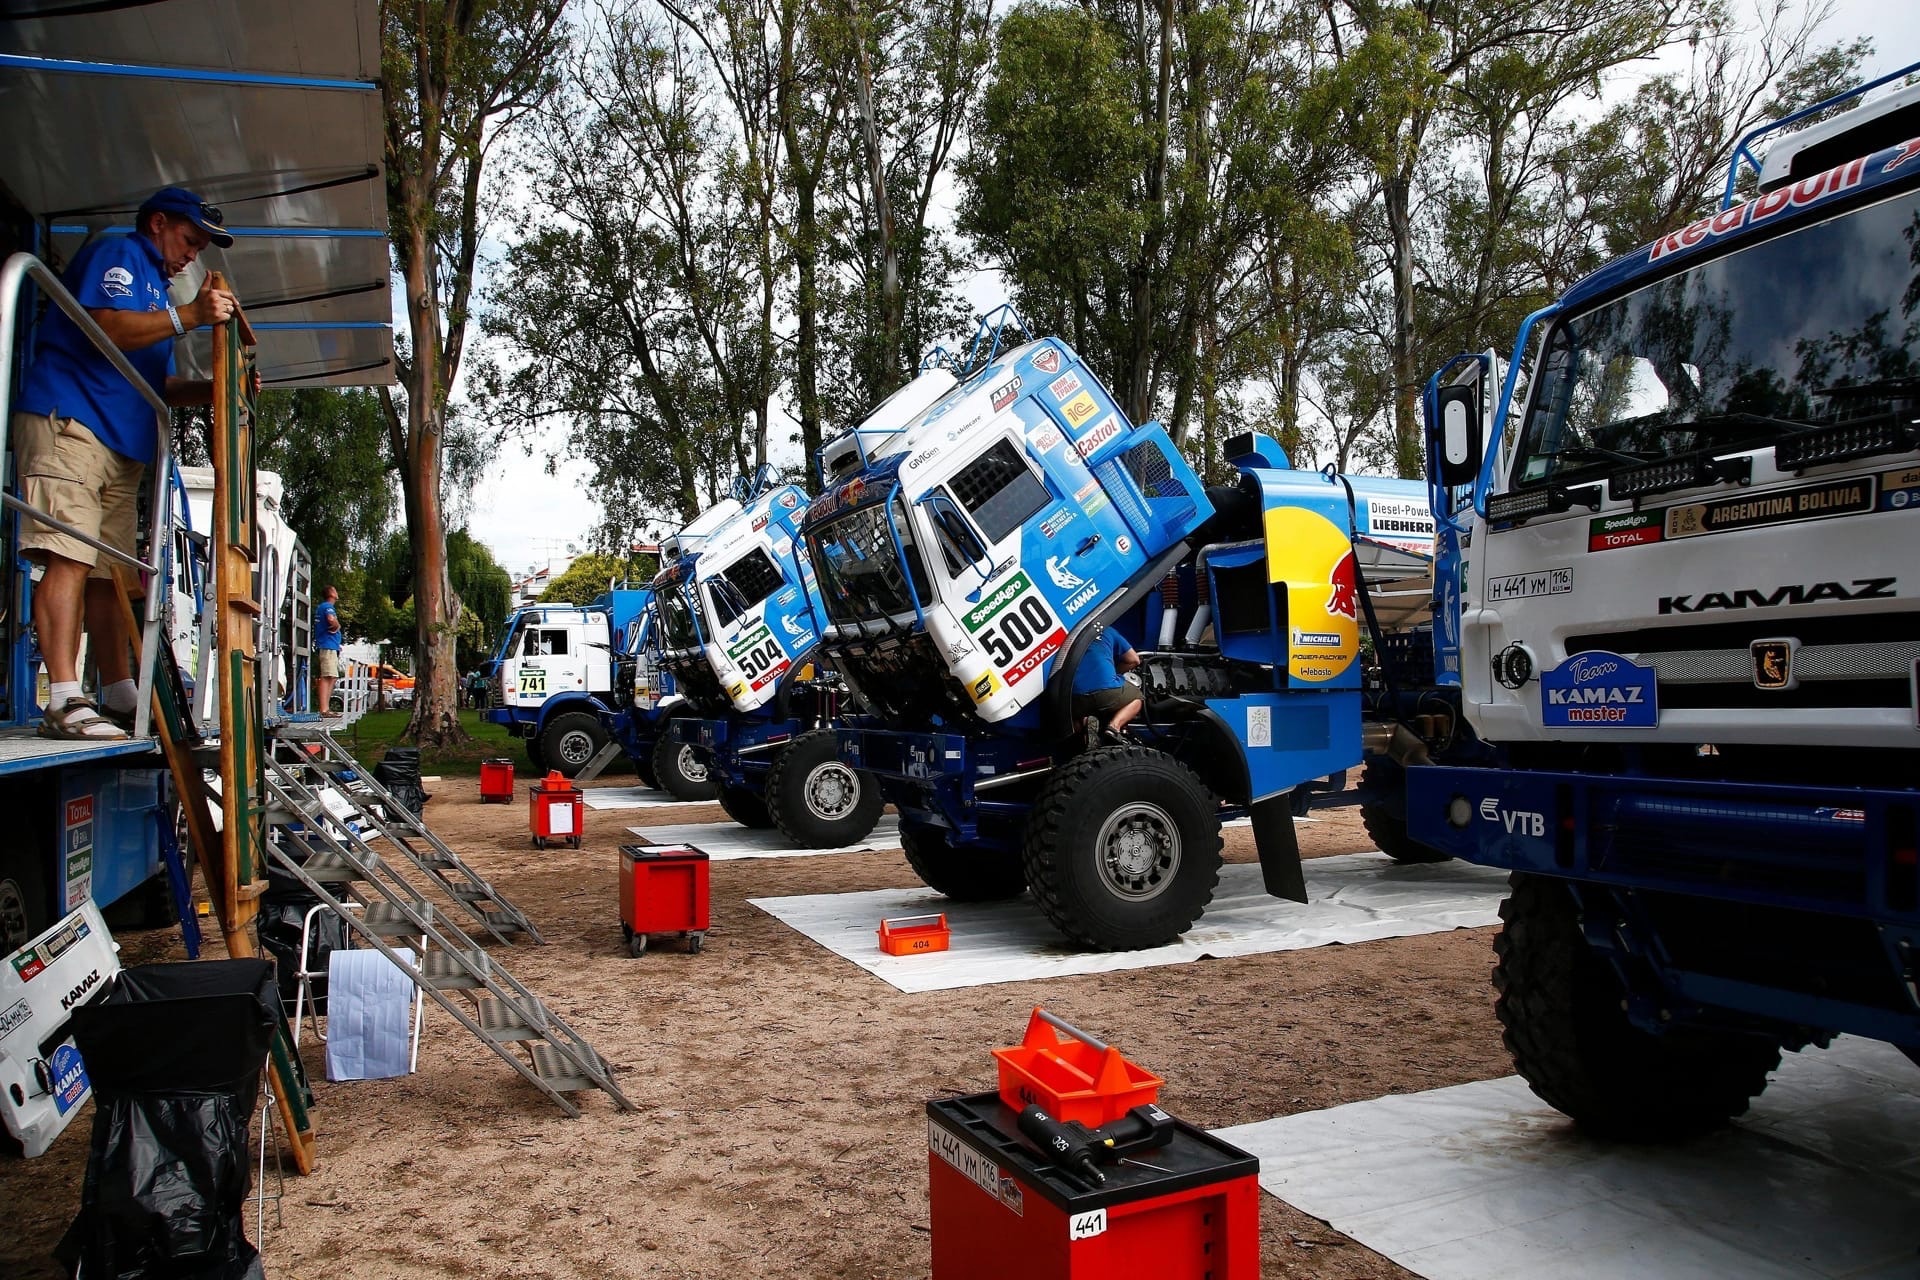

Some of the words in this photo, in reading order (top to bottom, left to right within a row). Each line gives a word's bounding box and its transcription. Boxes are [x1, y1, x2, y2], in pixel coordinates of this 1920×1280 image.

[1078, 418, 1118, 457] Castrol
[1711, 497, 1793, 525] ARGENTINA
[1798, 486, 1862, 511] BOLIVIA
[1372, 519, 1434, 534] LIEBHERR
[1603, 514, 1648, 530] SpeedAgro
[1604, 534, 1644, 545] TOTAL
[1504, 576, 1526, 597] 441
[1553, 570, 1569, 584] 116
[970, 580, 1022, 624] SpeedAgro
[1065, 583, 1100, 616] KAMAZ
[1657, 577, 1897, 615] KAMAZ
[978, 595, 1053, 669] 500
[1302, 635, 1340, 643] MICHELIN
[737, 638, 783, 680] 504
[1016, 643, 1057, 673] TOTAL
[1300, 667, 1332, 676] Webasto
[1569, 657, 1618, 685] Team
[520, 677, 545, 691] 741
[1548, 686, 1644, 705] KAMAZ
[1568, 705, 1627, 722] master
[69, 805, 91, 821] TOTAL
[1503, 809, 1545, 837] VTB
[912, 939, 930, 950] 404
[61, 969, 100, 1010] KAMAZ
[54, 1063, 84, 1097] KAMAZ
[942, 1133, 960, 1168] 441
[982, 1160, 995, 1181] 116
[1076, 1214, 1101, 1234] 441
